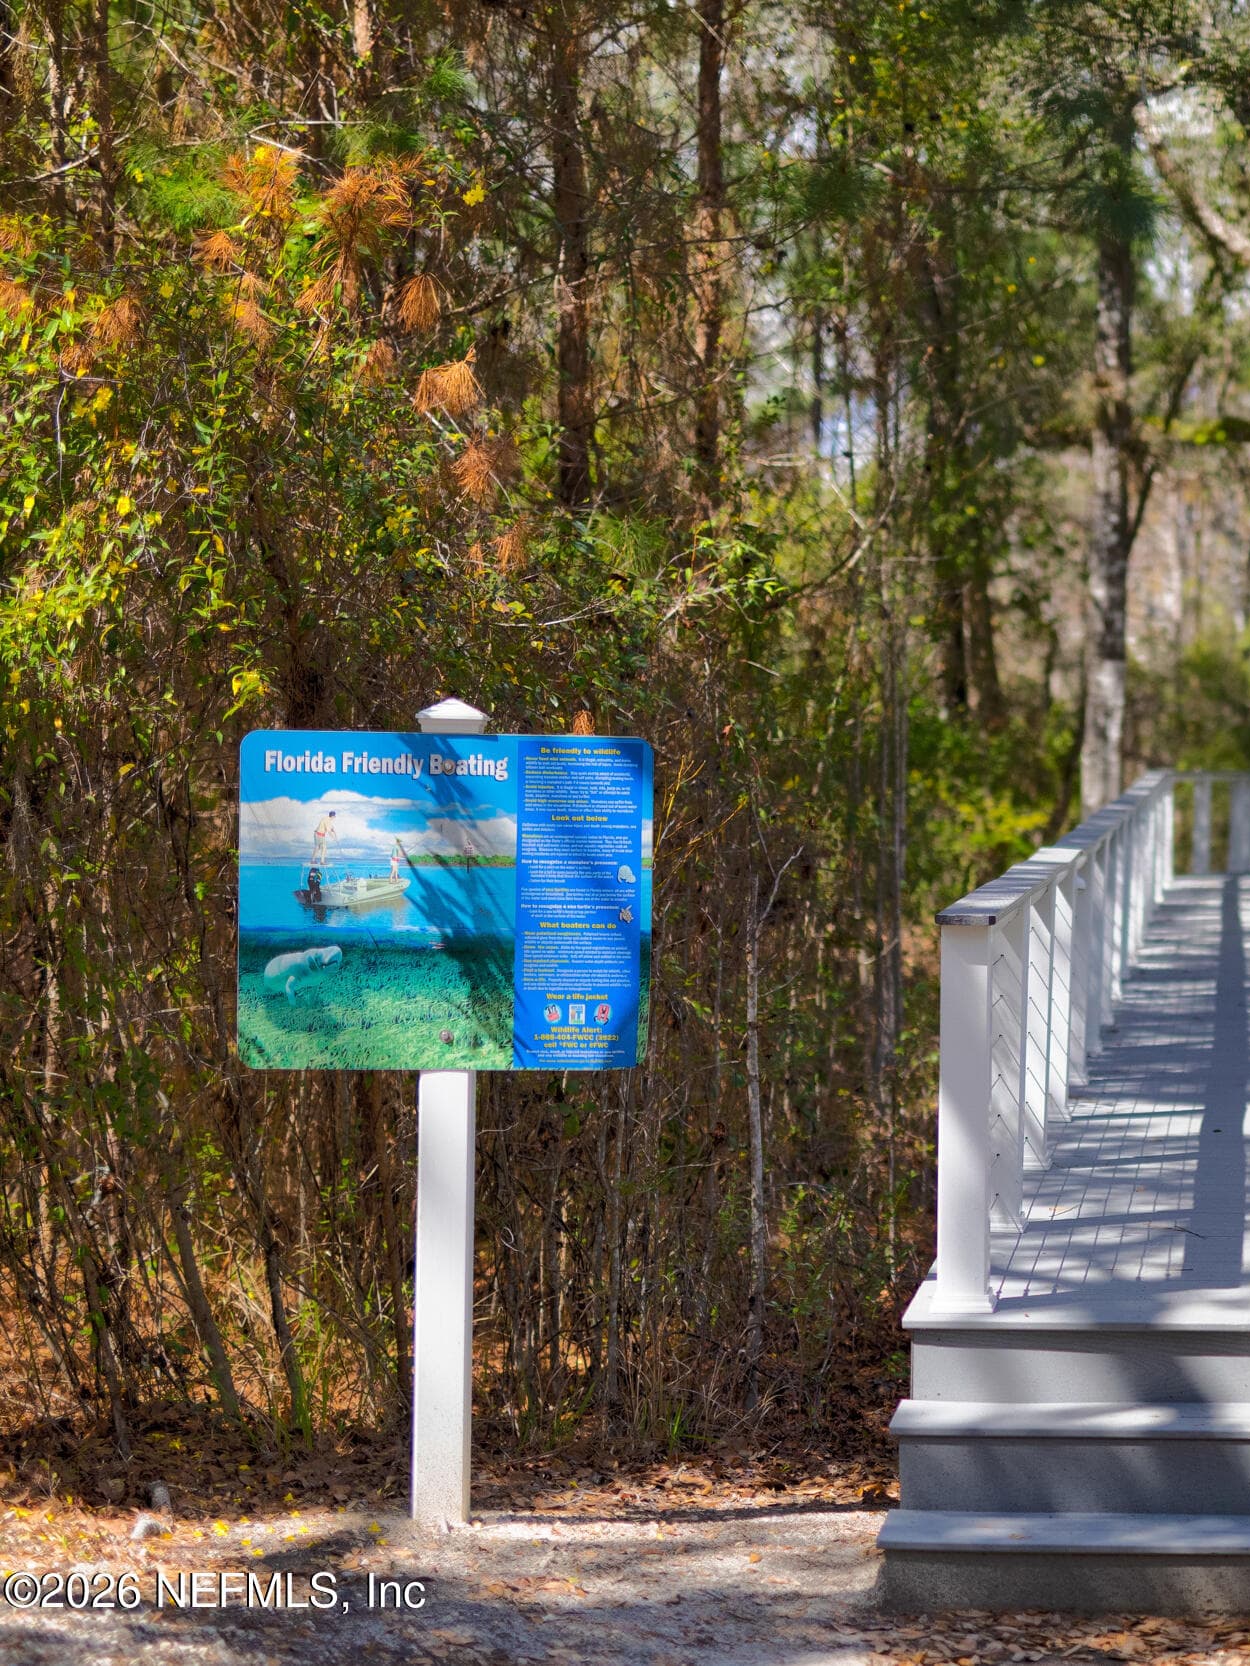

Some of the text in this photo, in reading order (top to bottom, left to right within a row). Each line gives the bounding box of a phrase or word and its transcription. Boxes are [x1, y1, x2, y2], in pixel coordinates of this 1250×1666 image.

[552, 747, 582, 755] friendly
[264, 750, 336, 773] Florida
[341, 751, 424, 779] Friendly
[585, 993, 608, 1001] jacket
